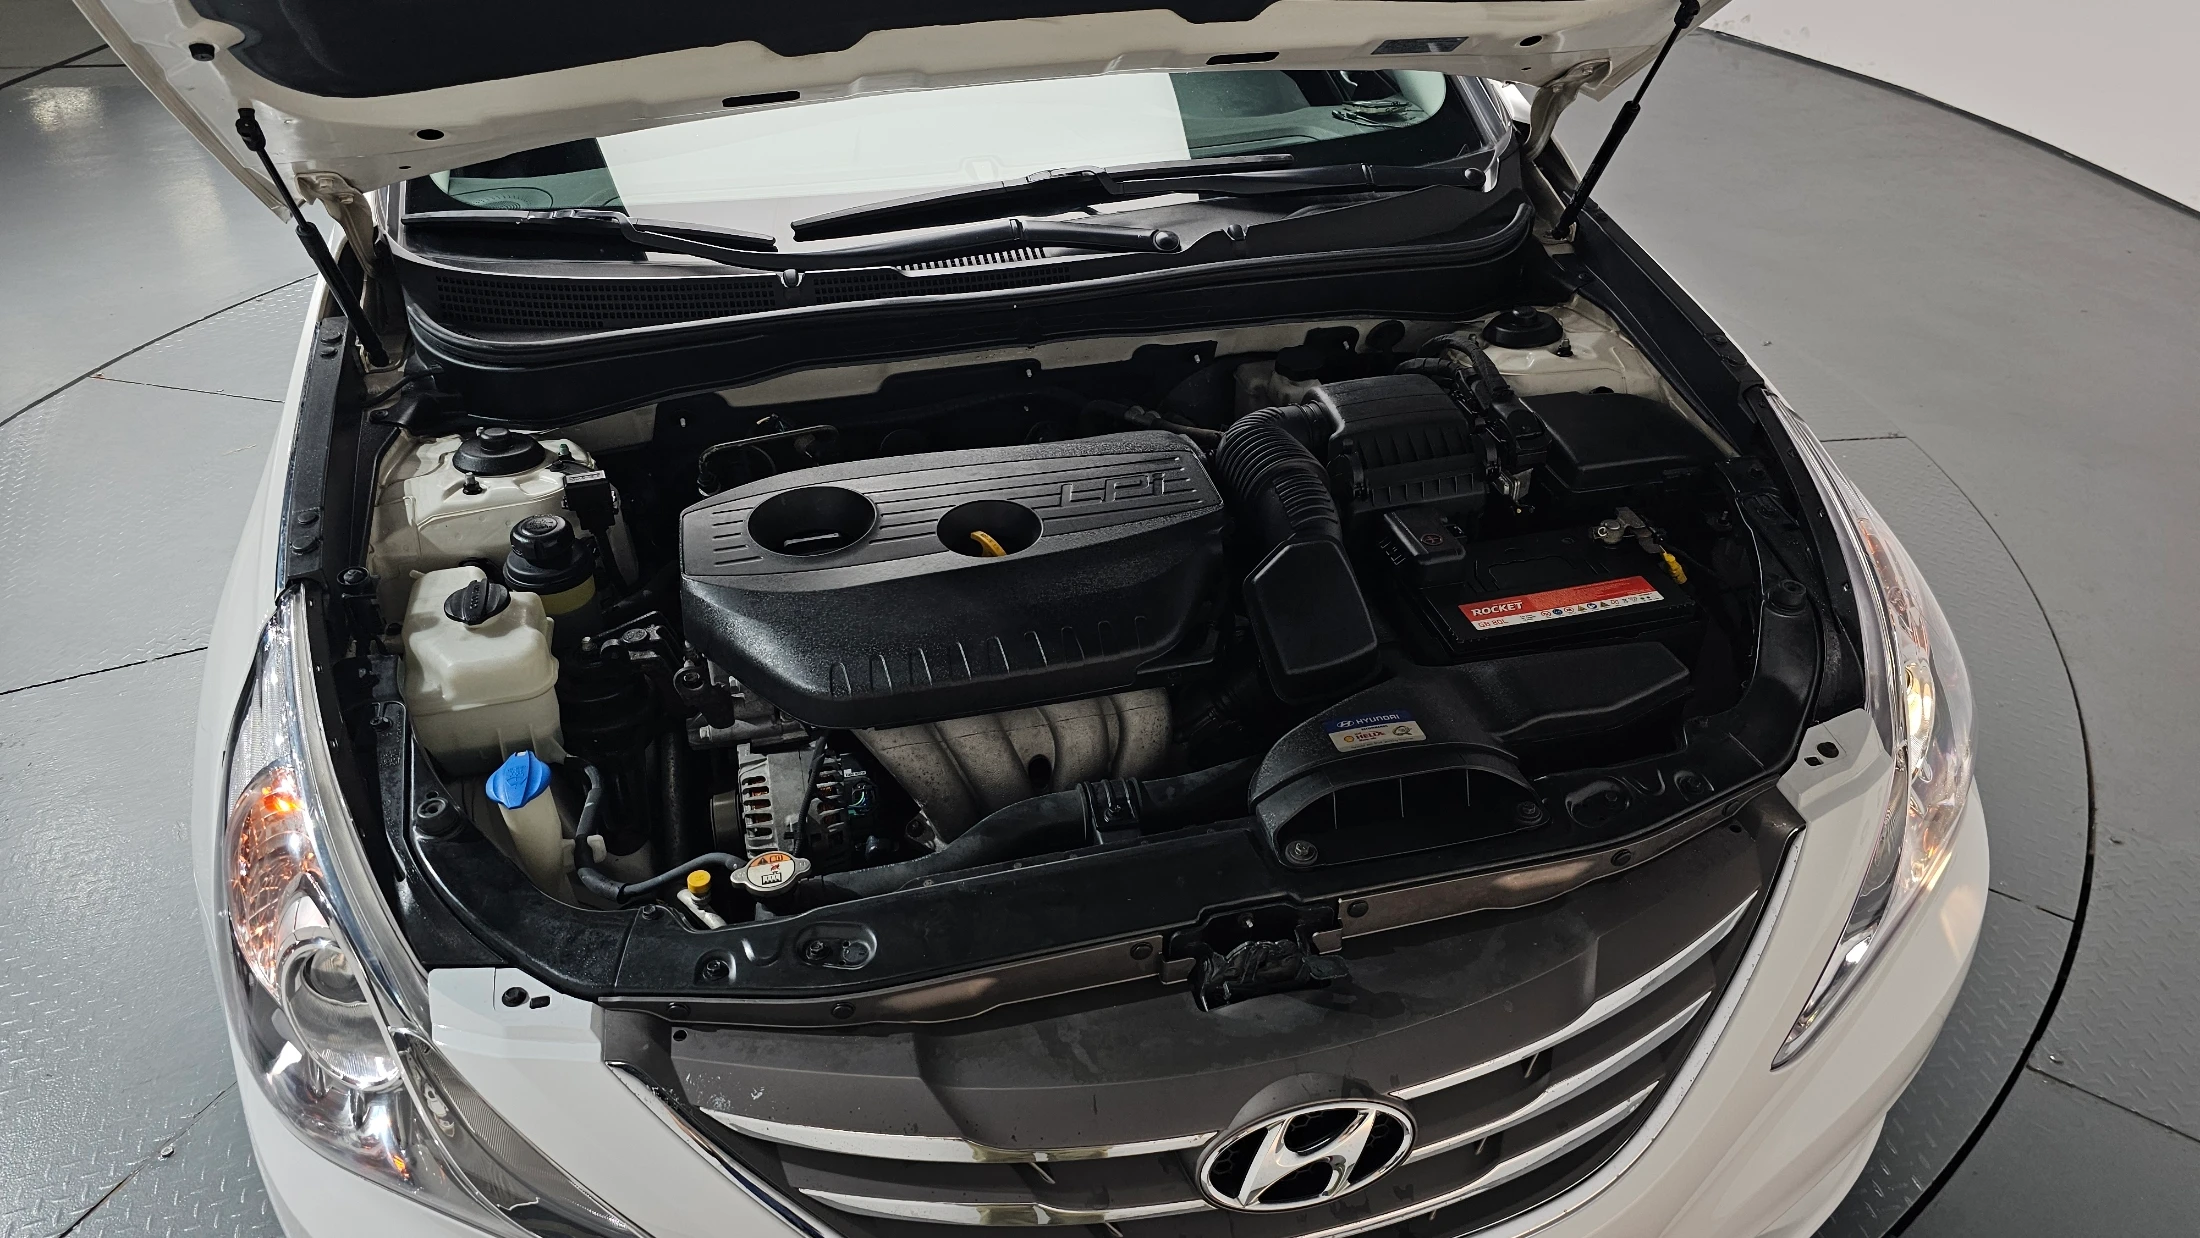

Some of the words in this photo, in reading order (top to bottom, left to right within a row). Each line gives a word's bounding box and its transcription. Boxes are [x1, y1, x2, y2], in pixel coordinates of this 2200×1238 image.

[1060, 472, 1166, 507] LPi
[1470, 602, 1523, 617] ROCKET
[1356, 714, 1400, 725] HYUNDAI
[1356, 731, 1385, 740] HELIX
